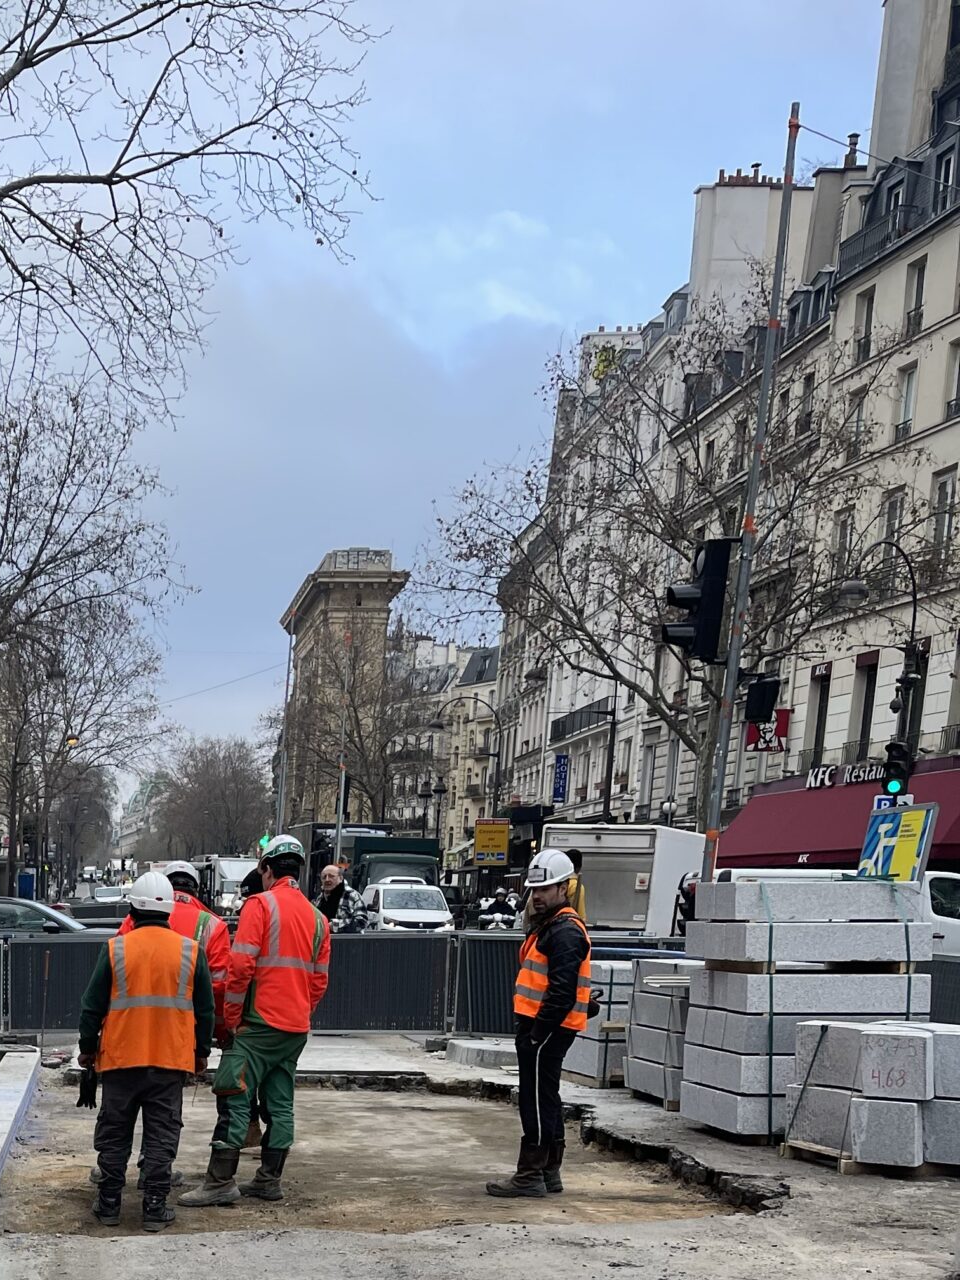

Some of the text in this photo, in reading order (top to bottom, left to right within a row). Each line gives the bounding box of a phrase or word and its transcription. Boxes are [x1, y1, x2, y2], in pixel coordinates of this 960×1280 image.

[815, 663, 828, 676] KFC
[805, 765, 837, 789] KFC
[881, 800, 890, 810] P
[797, 854, 810, 863] KFC
